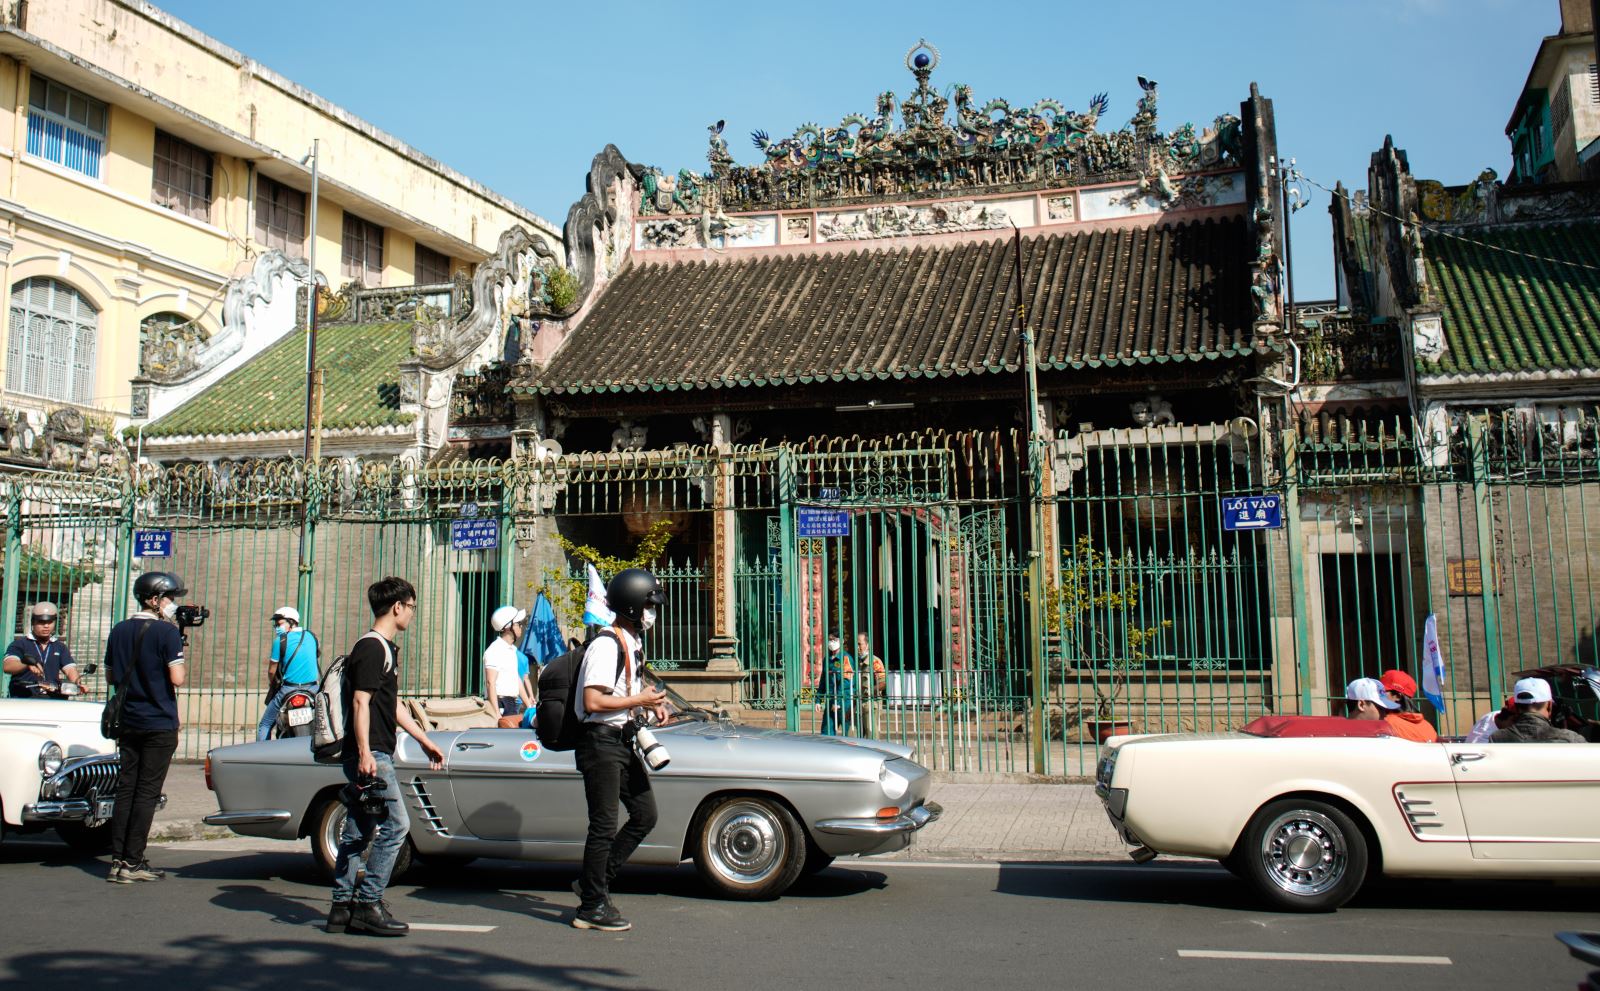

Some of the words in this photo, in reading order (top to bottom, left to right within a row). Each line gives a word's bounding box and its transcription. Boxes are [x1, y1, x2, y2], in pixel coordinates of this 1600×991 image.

[823, 489, 837, 498] 710
[1227, 499, 1248, 510] LỐI
[1250, 499, 1276, 509] VÀO
[140, 533, 153, 541] LỐI
